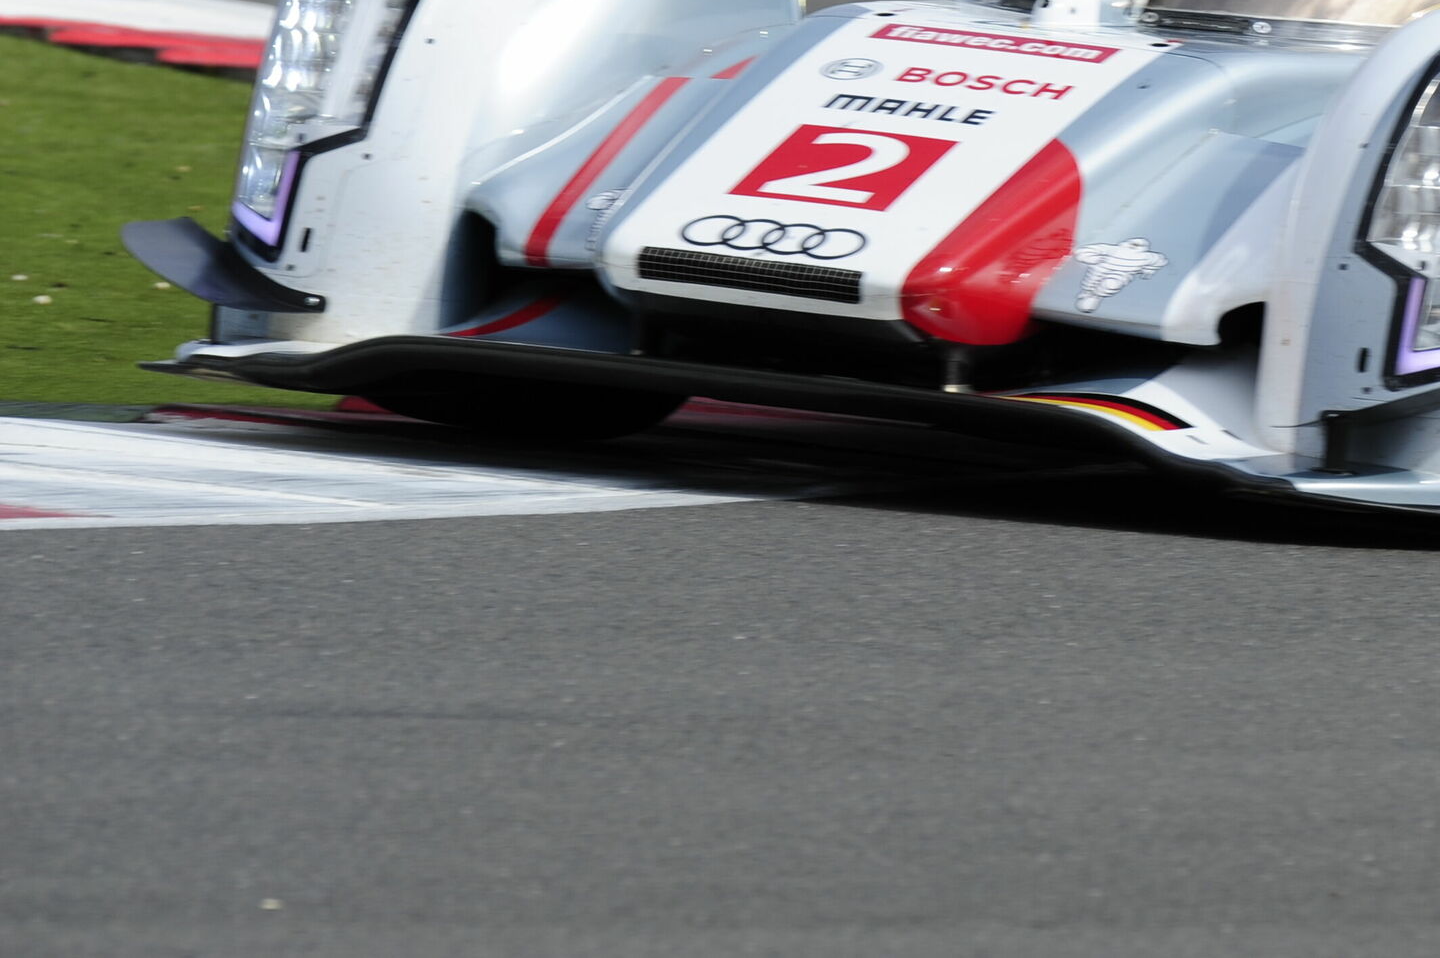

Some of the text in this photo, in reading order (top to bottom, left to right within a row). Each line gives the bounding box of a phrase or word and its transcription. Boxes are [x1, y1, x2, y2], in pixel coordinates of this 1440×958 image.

[886, 26, 1104, 61] fiawec.com
[893, 66, 1074, 101] BOSCH
[822, 93, 997, 126] MAHLE
[756, 132, 911, 204] 2
